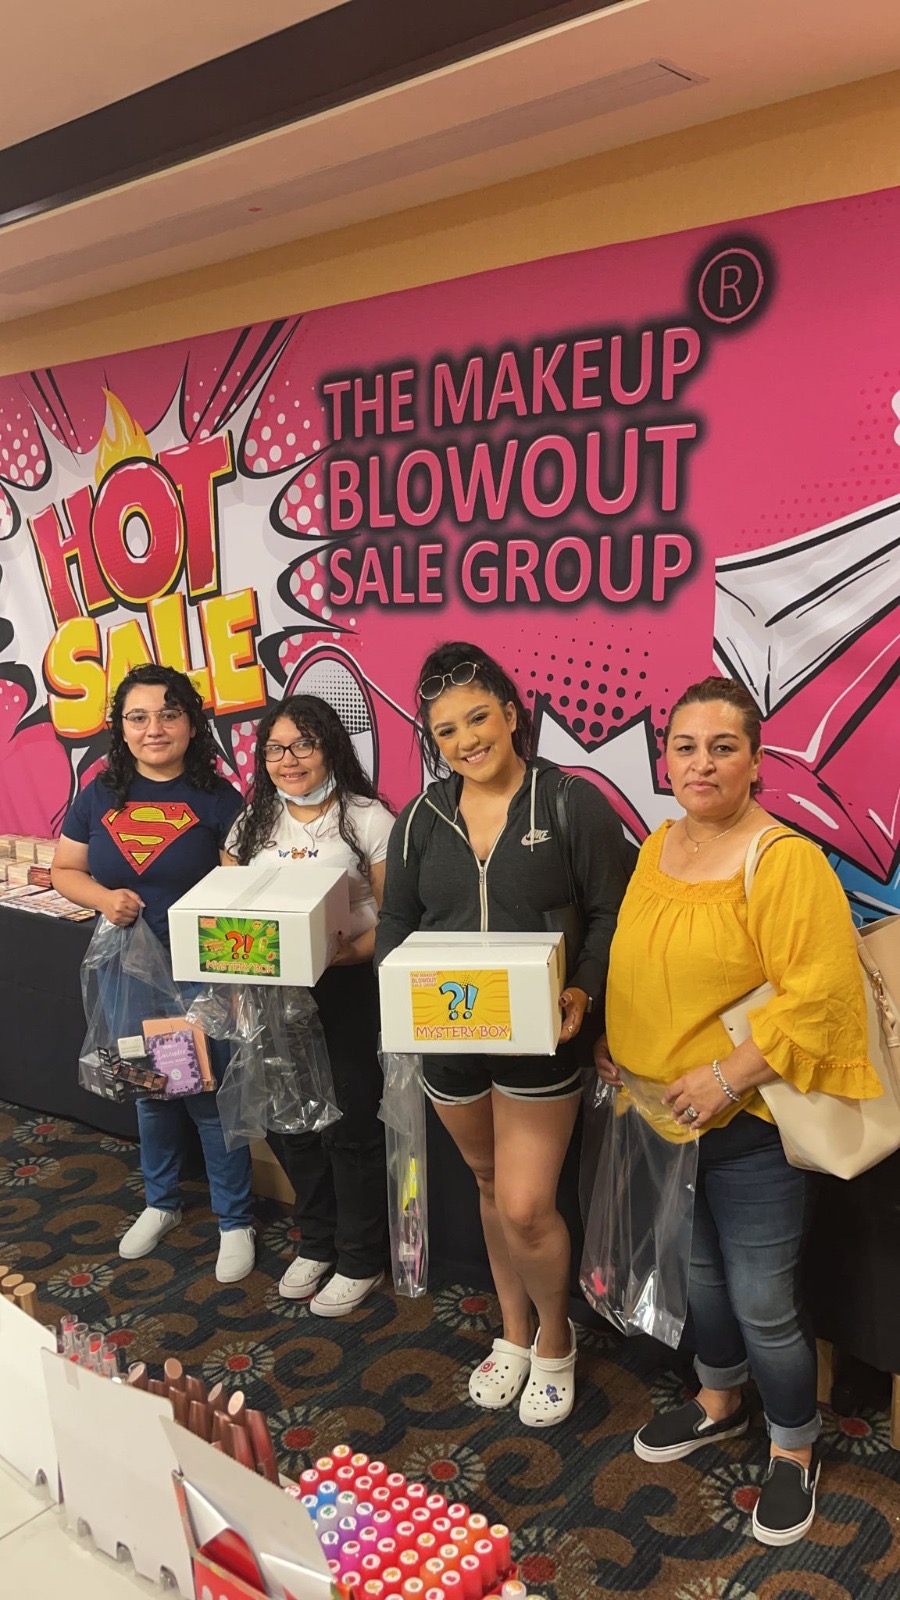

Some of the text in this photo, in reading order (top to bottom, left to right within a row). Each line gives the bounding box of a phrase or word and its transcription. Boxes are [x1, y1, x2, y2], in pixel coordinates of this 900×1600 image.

[323, 326, 701, 440] THE MAKEUP
[29, 430, 237, 628] HOT
[330, 423, 697, 531] BLOWOUT
[330, 534, 692, 605] SALE GROUP
[45, 588, 266, 738] SALE
[252, 962, 275, 975] BOX
[416, 1025, 508, 1038] MYSTERY BOX
